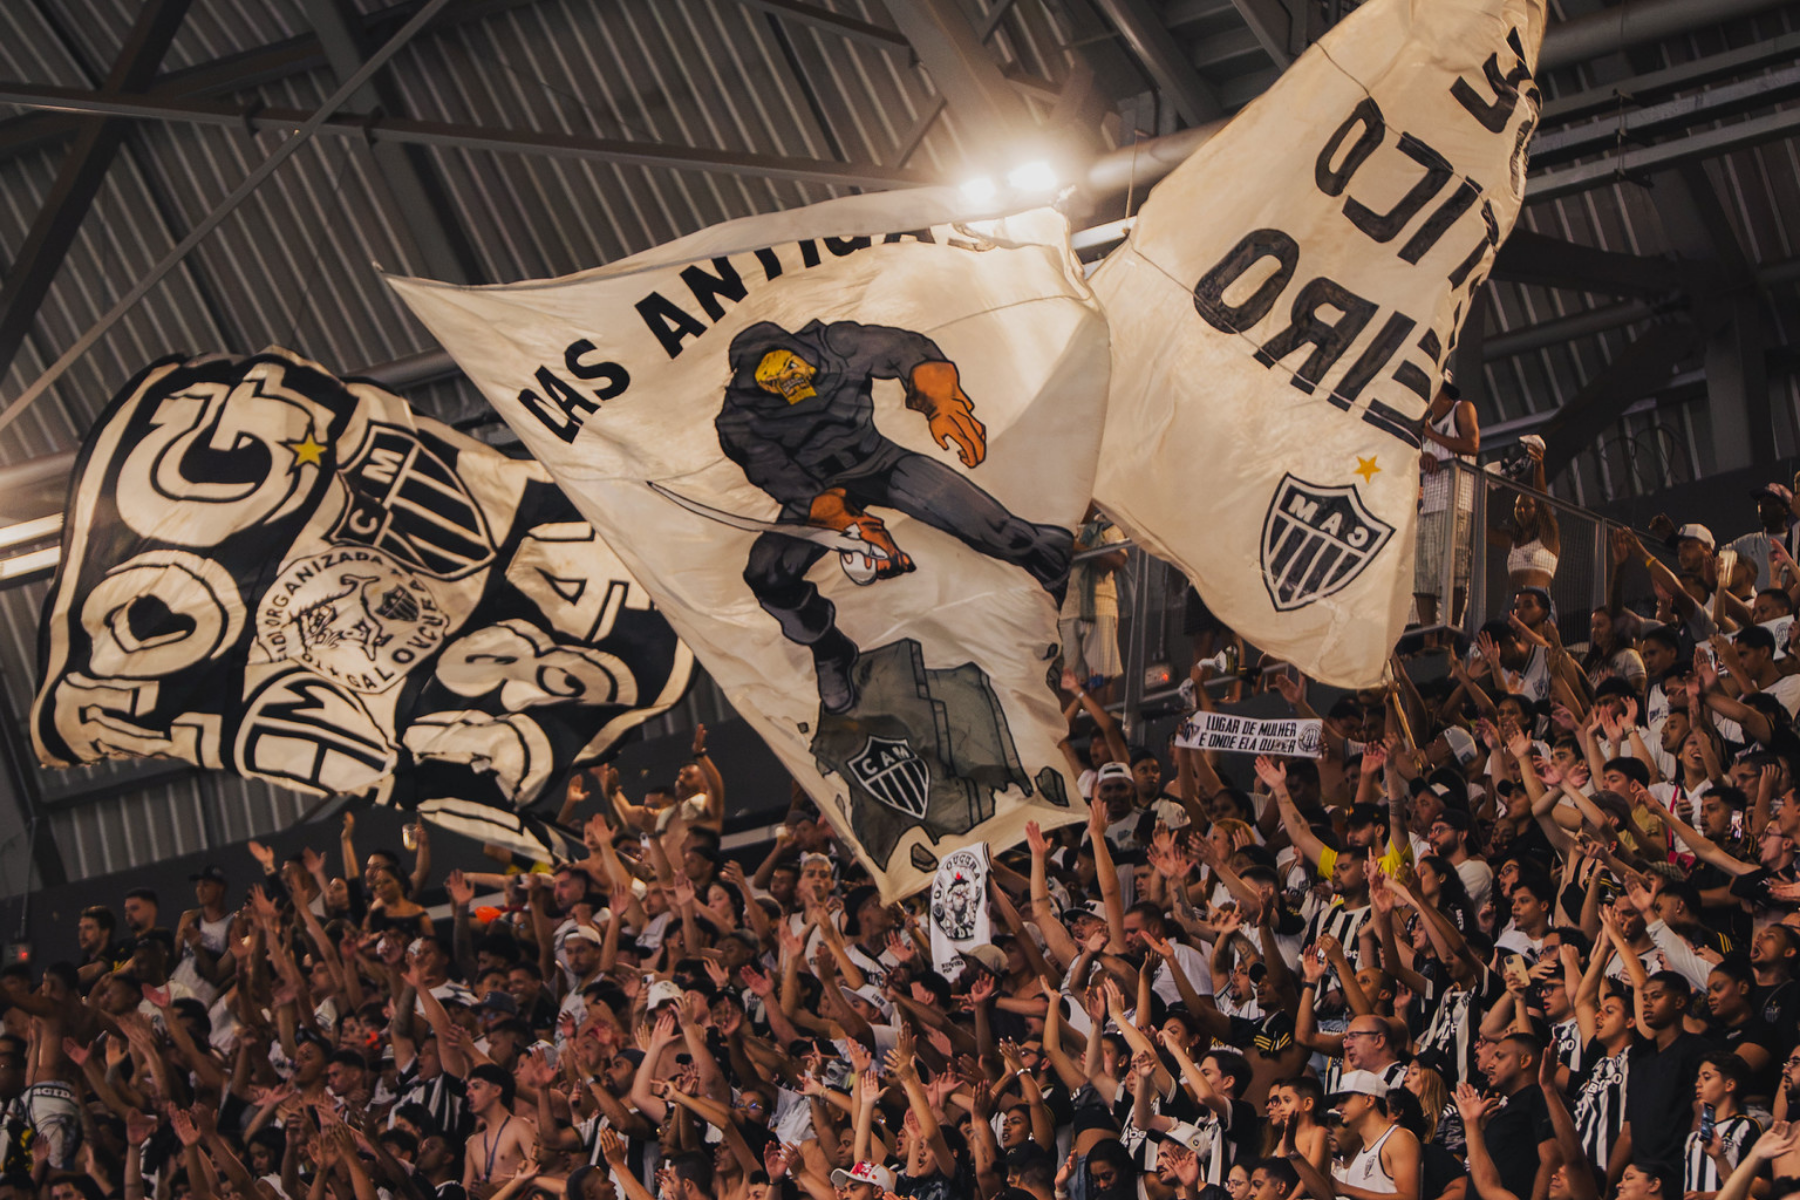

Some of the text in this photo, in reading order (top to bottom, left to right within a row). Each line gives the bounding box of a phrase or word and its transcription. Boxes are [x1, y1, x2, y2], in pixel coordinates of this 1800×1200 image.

[349, 447, 405, 535] CM
[265, 552, 383, 626] ORGANIZADA
[1206, 715, 1240, 735] LUGAR
[1242, 720, 1257, 736] DE
[1257, 722, 1297, 738] MULHER
[1208, 734, 1236, 749] ONDE
[1238, 736, 1257, 751] ELA
[861, 746, 910, 775] CAM
